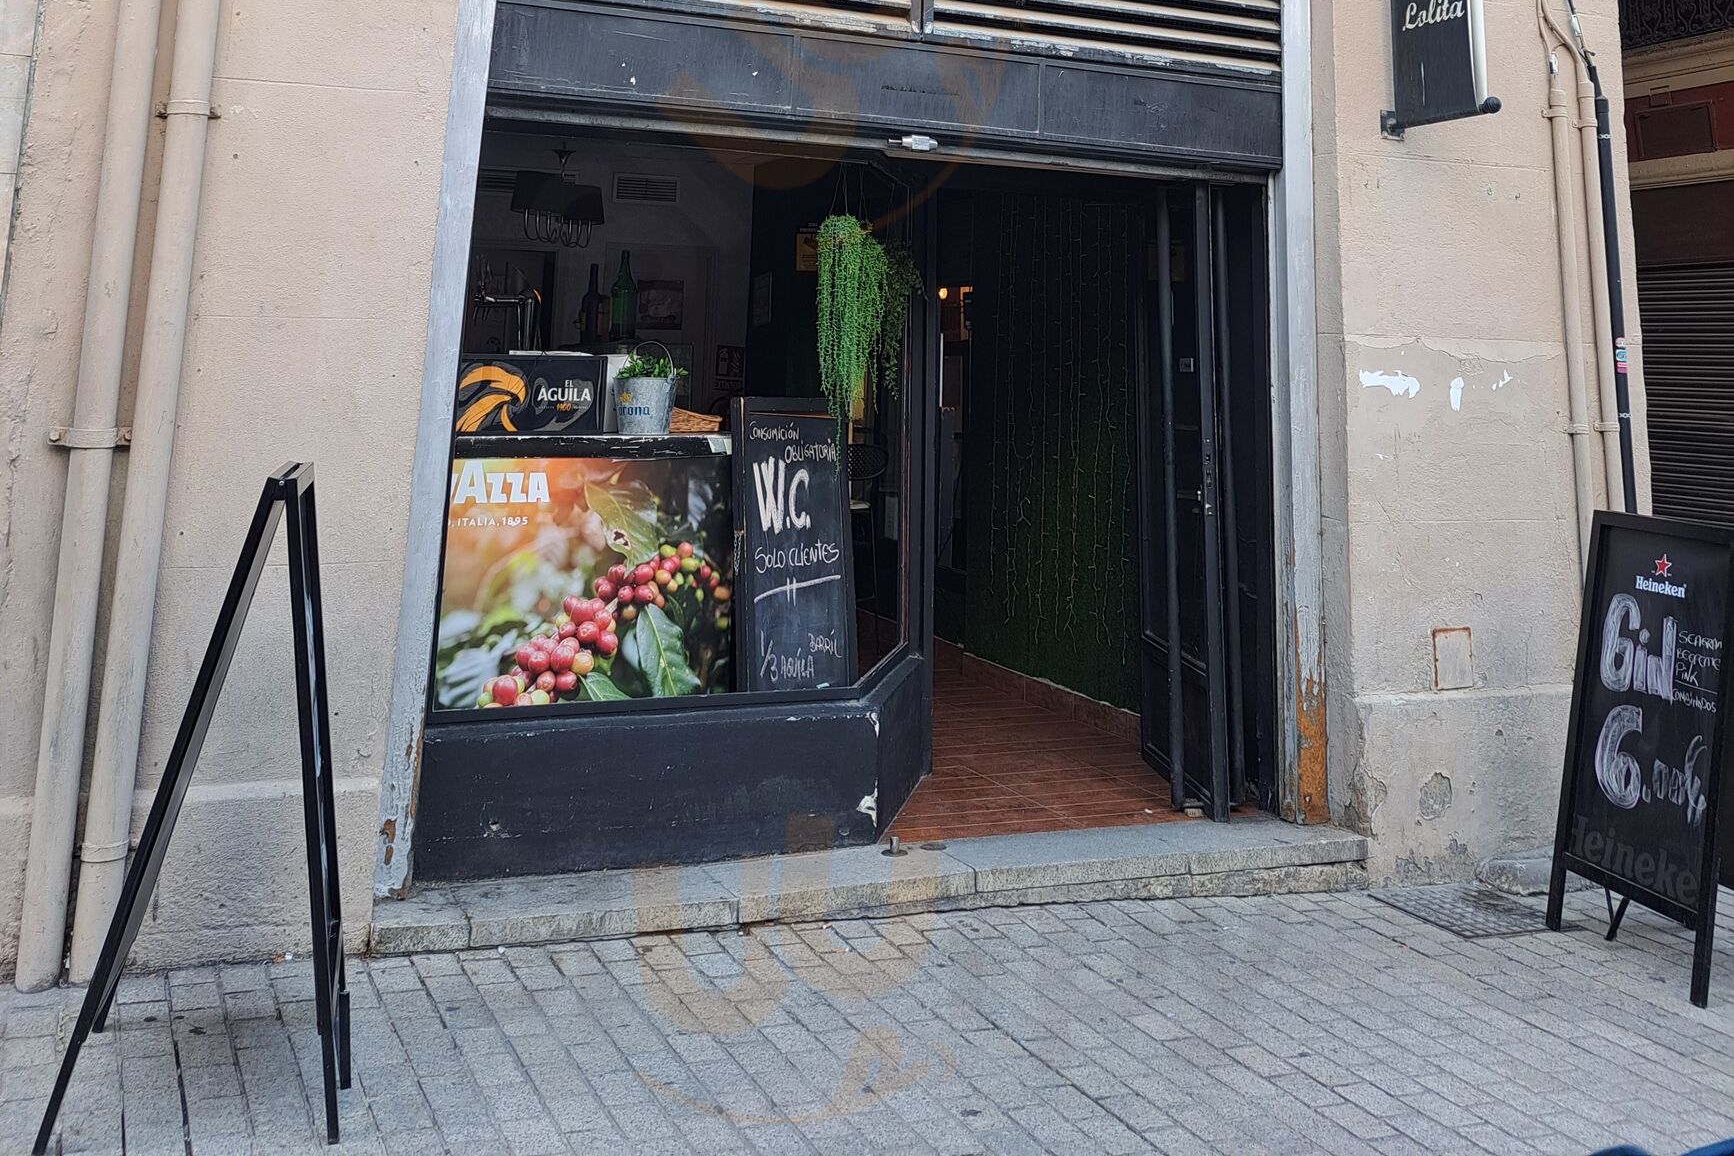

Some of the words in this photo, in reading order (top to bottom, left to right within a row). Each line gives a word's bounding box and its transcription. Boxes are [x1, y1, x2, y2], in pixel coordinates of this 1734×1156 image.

[564, 379, 574, 388] EL
[617, 406, 650, 417] orona
[755, 546, 785, 573] SOLO
[1635, 575, 1687, 598] Heineken
